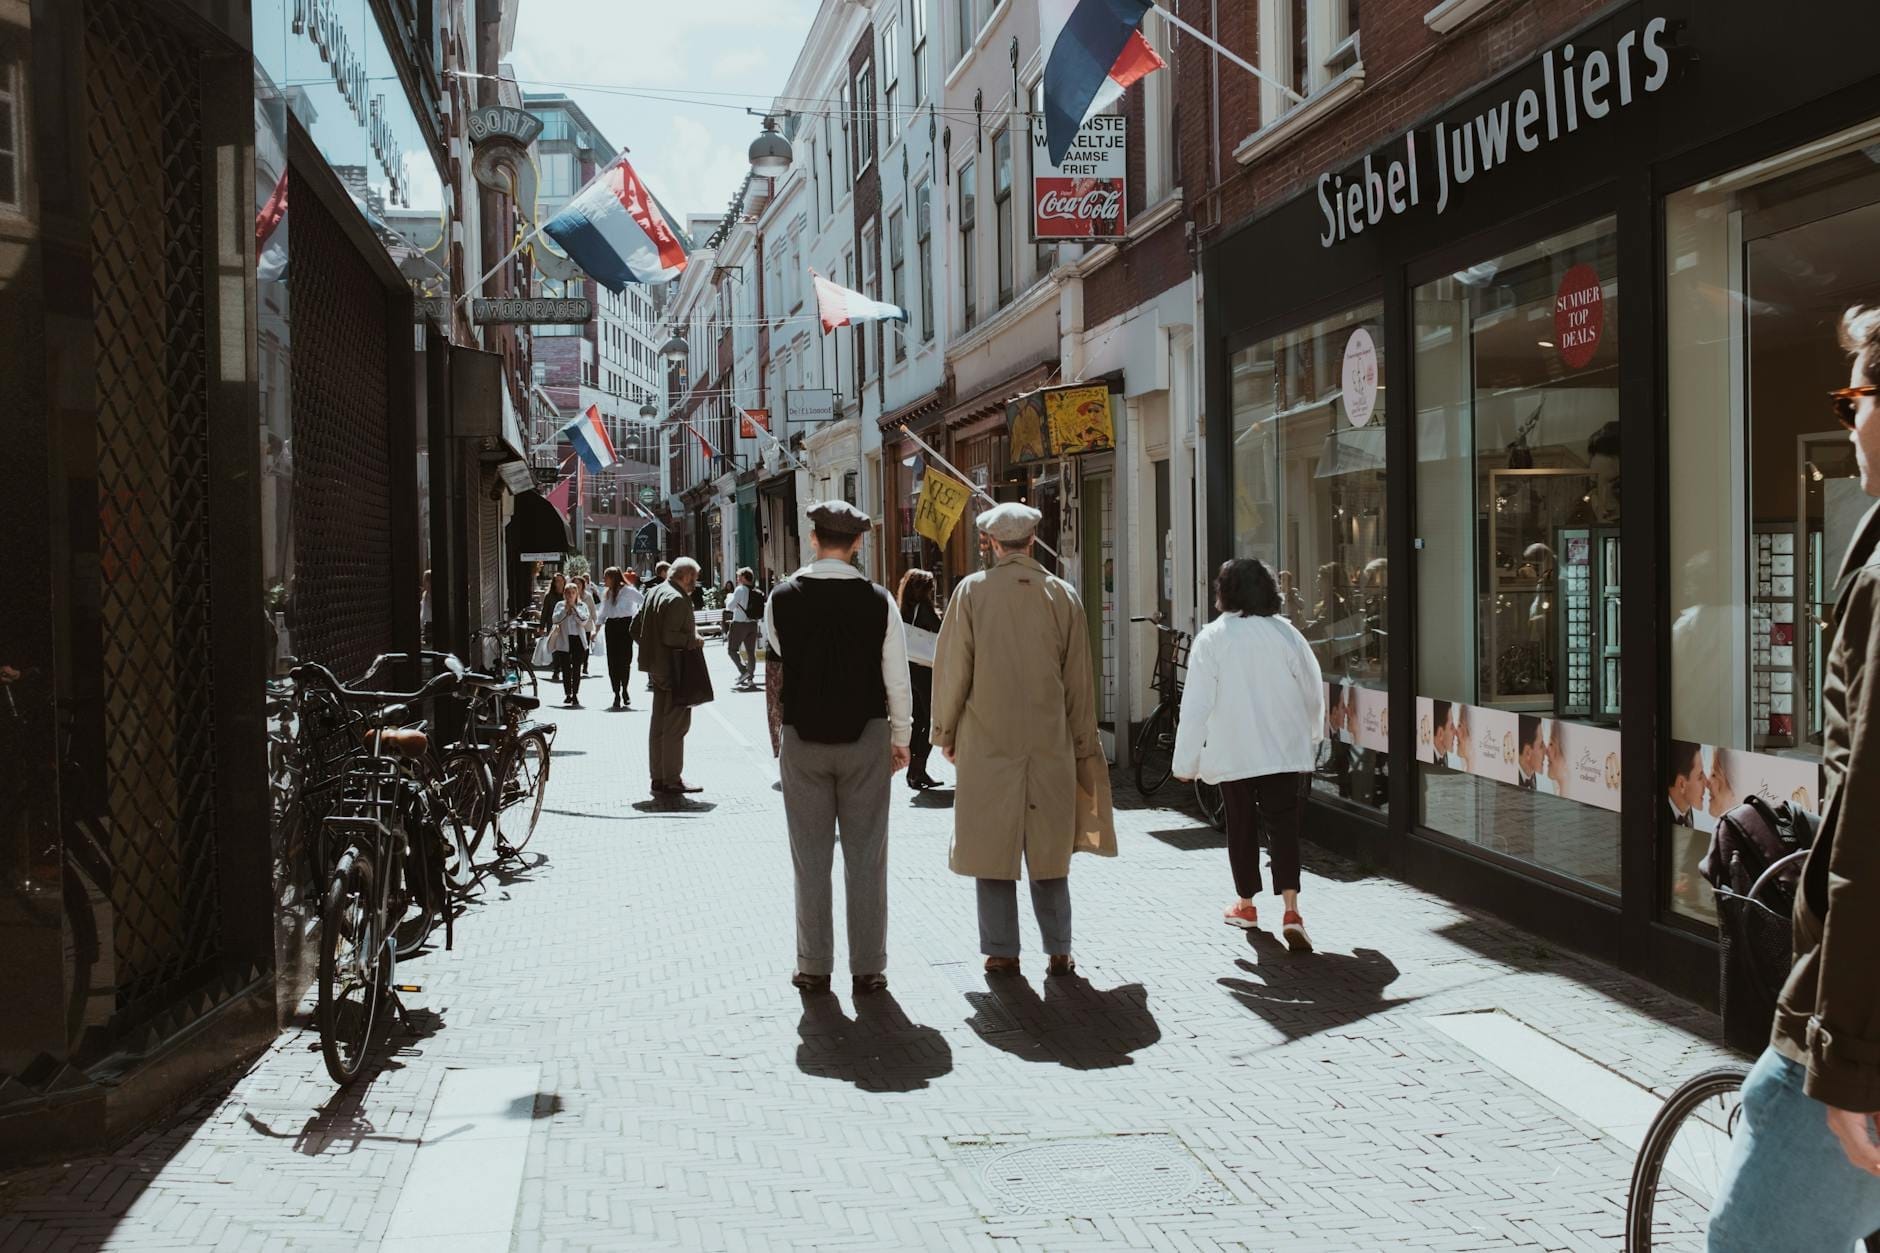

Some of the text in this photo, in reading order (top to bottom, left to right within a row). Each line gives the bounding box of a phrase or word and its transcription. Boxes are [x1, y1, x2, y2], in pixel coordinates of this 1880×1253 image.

[467, 109, 536, 138] BONT
[1316, 16, 1671, 249] Siebel Juweliers
[1063, 151, 1109, 161] AAMSE
[1062, 165, 1098, 174] FRIET
[486, 300, 588, 319] WORDRAGEN
[1556, 285, 1601, 313] SUMMER
[1567, 308, 1589, 328] TOP
[1562, 325, 1596, 349] DEALS
